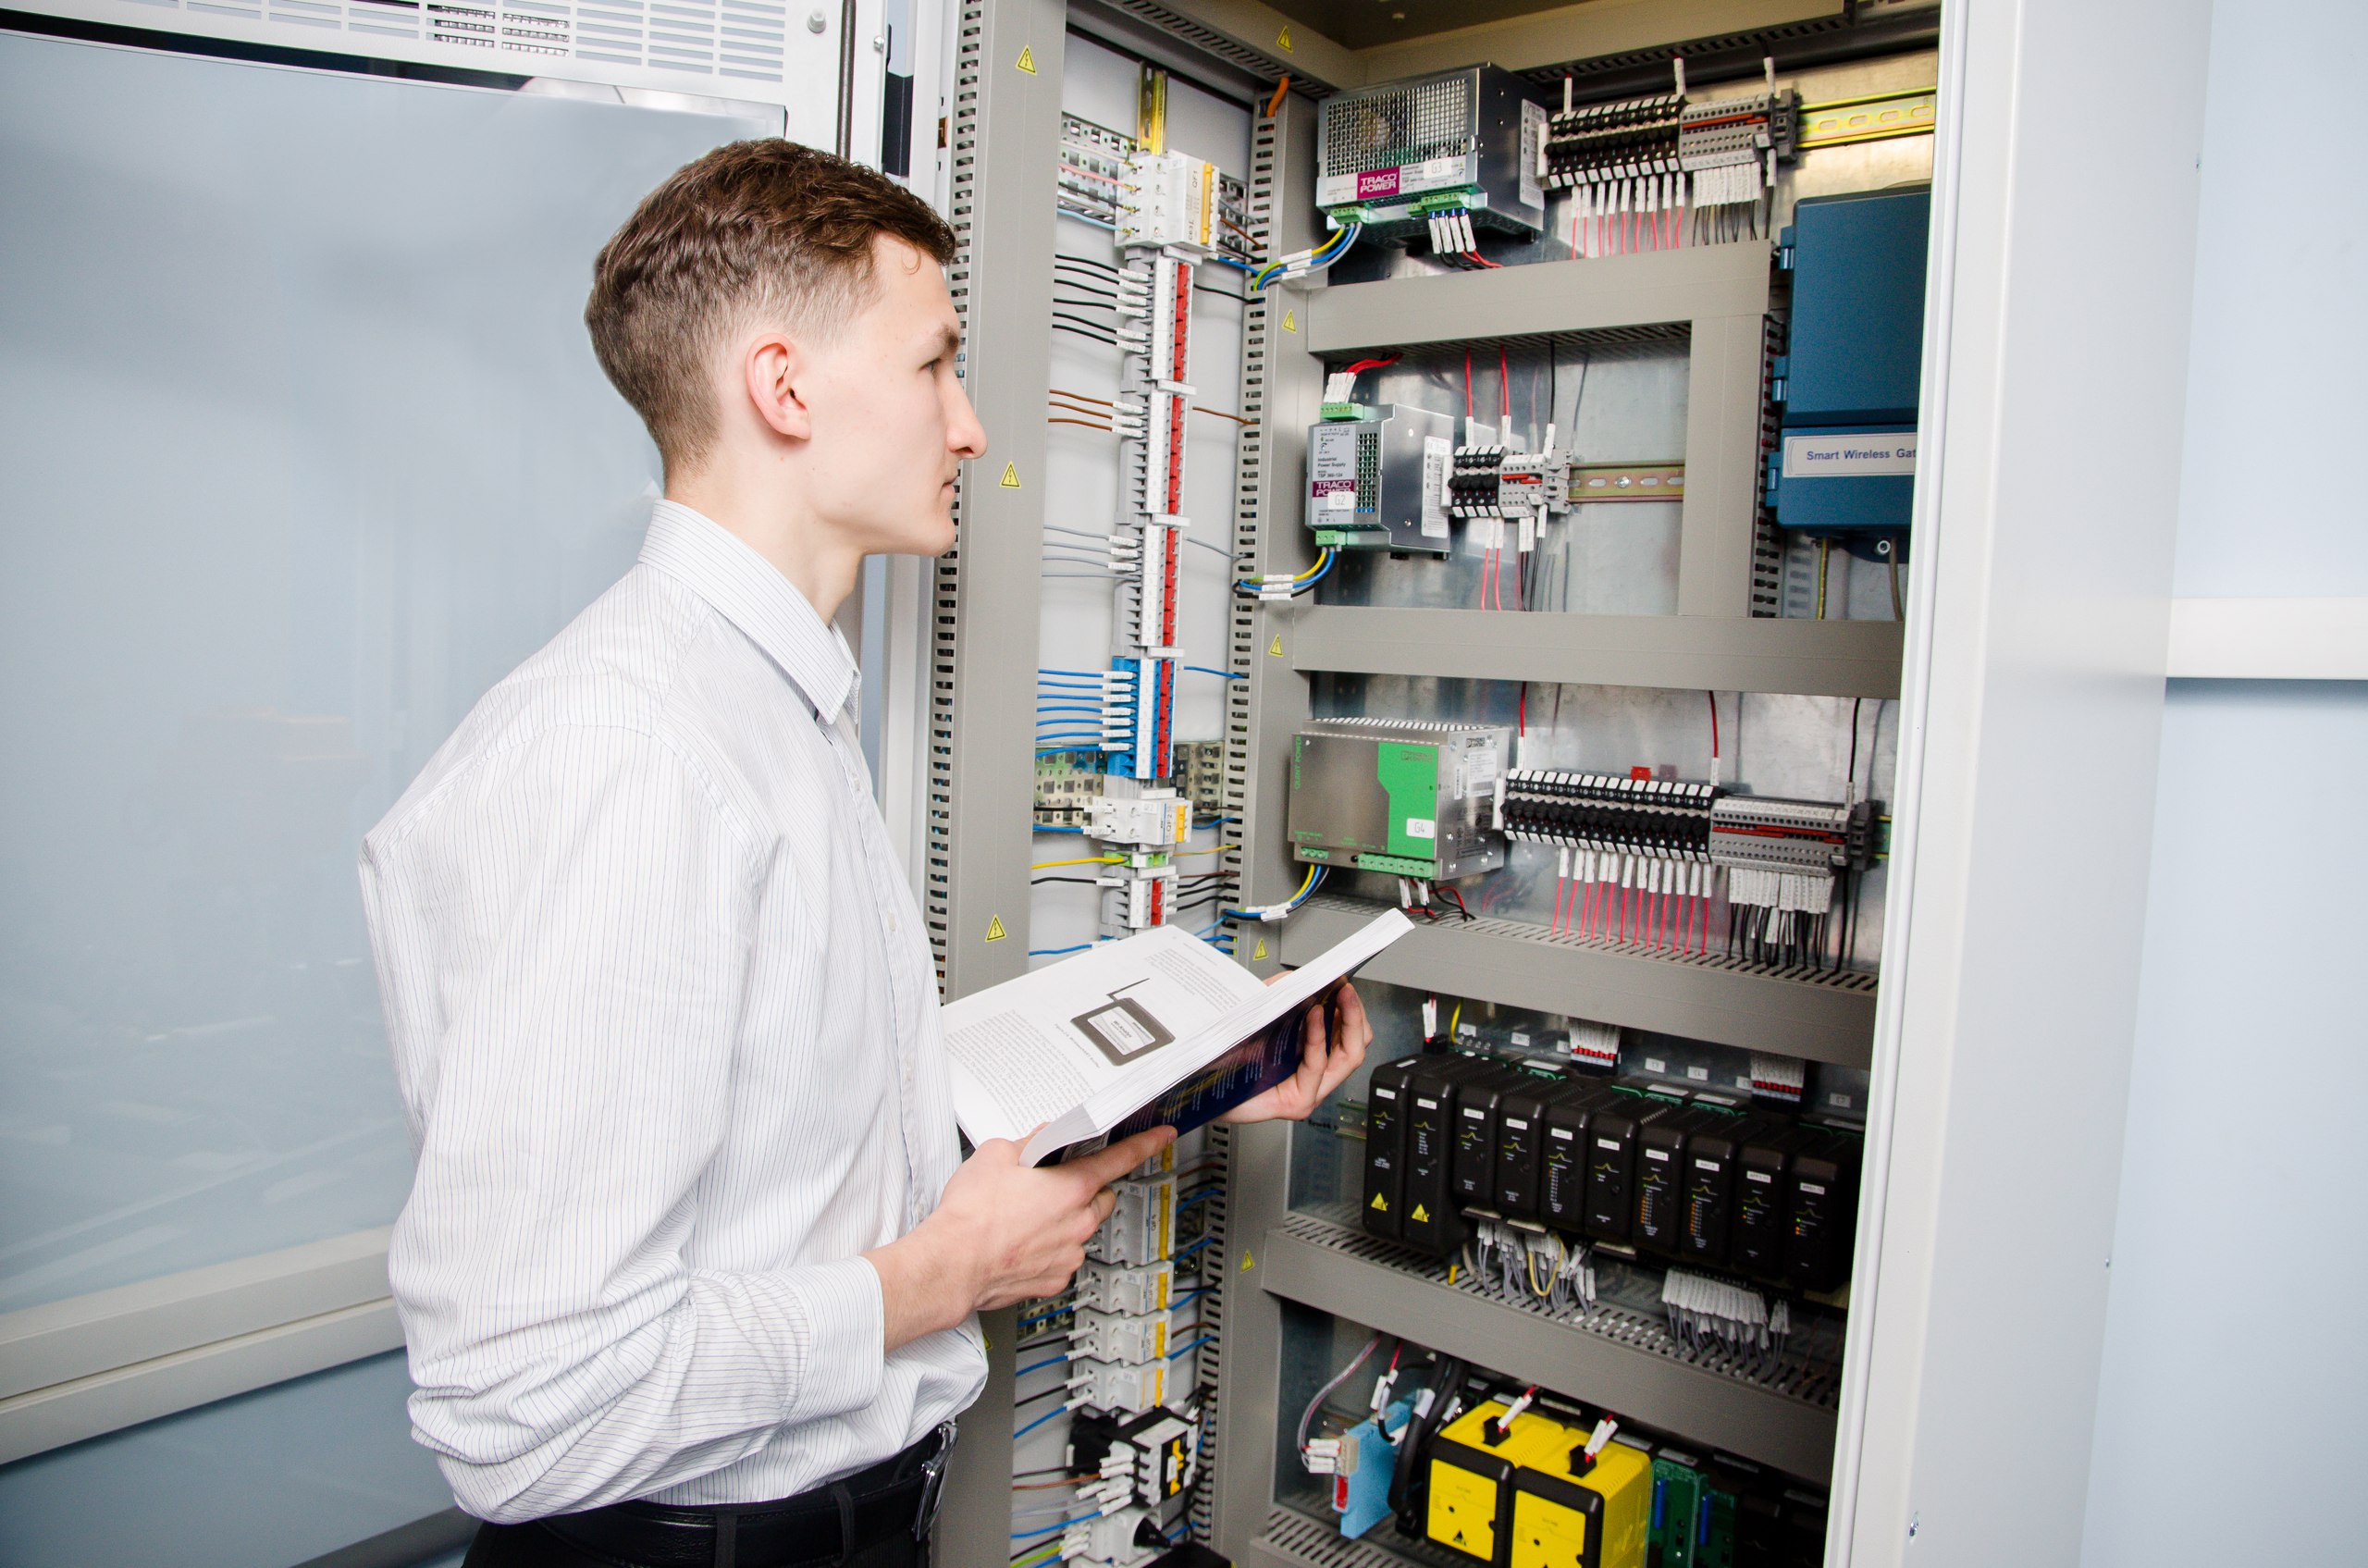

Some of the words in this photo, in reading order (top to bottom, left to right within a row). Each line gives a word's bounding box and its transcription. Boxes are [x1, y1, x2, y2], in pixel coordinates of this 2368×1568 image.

[1432, 161, 1442, 174] G3
[1360, 173, 1398, 186] TRACO
[1360, 182, 1397, 193] POWER
[1807, 451, 1840, 461] Smart
[1844, 450, 1891, 460] Wireless
[1317, 480, 1351, 489] TRACO
[1335, 494, 1346, 506] G2
[1414, 821, 1425, 833] G4
